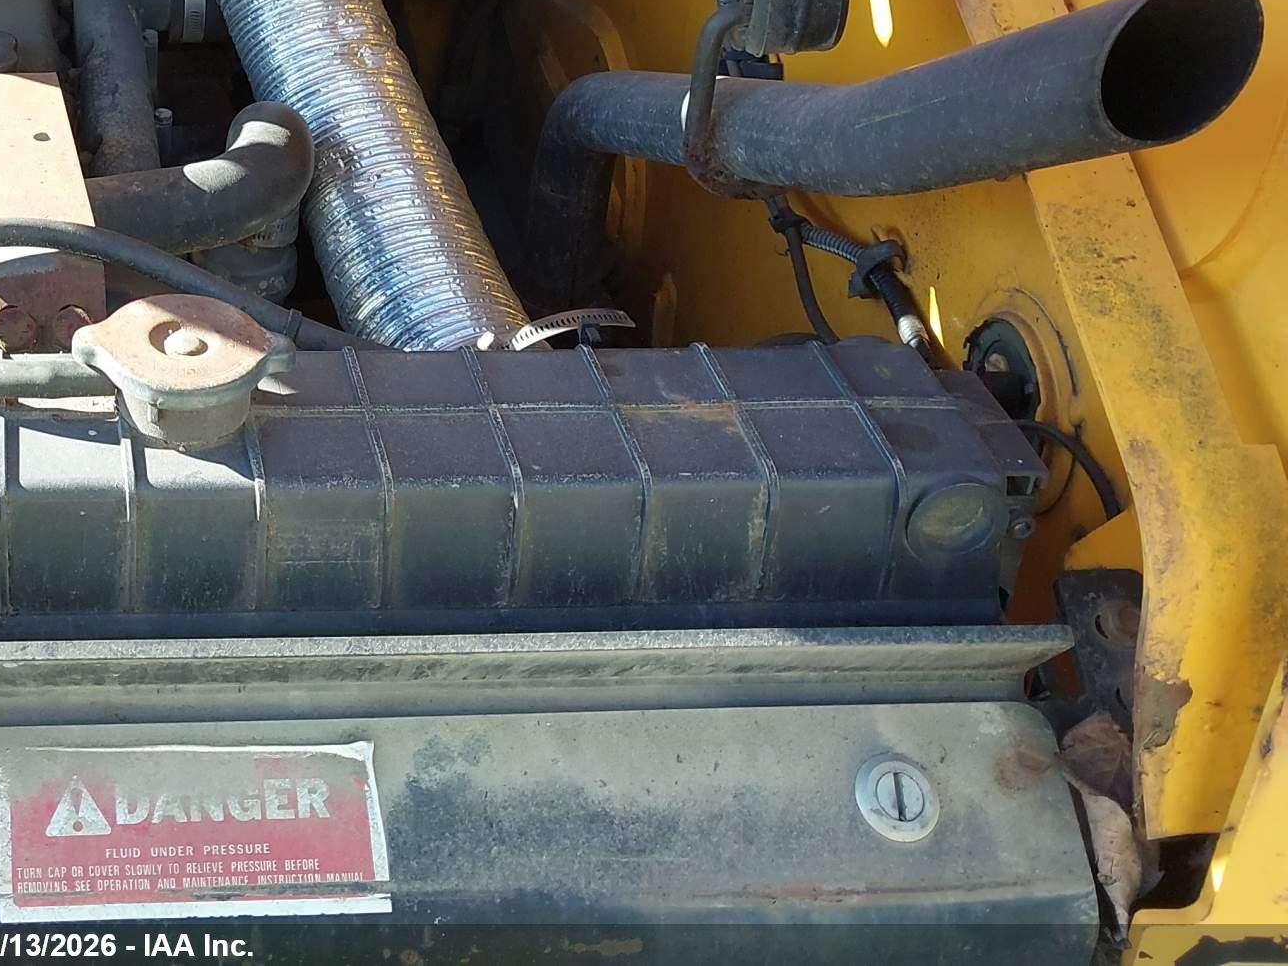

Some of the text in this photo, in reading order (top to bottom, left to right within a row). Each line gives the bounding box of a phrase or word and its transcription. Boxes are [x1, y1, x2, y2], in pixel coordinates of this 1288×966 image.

[114, 778, 331, 825] DANGER
[105, 843, 271, 859] FLUID UNDER PRESSURE
[16, 858, 320, 880] TURN CAP OR COVER SLOWLY TO RELIEVE PRESSURE BEFORE
[75, 880, 92, 892] SEE
[97, 878, 150, 891] OPERATION
[158, 877, 177, 890] AND
[182, 875, 250, 889] MAINTENANCE
